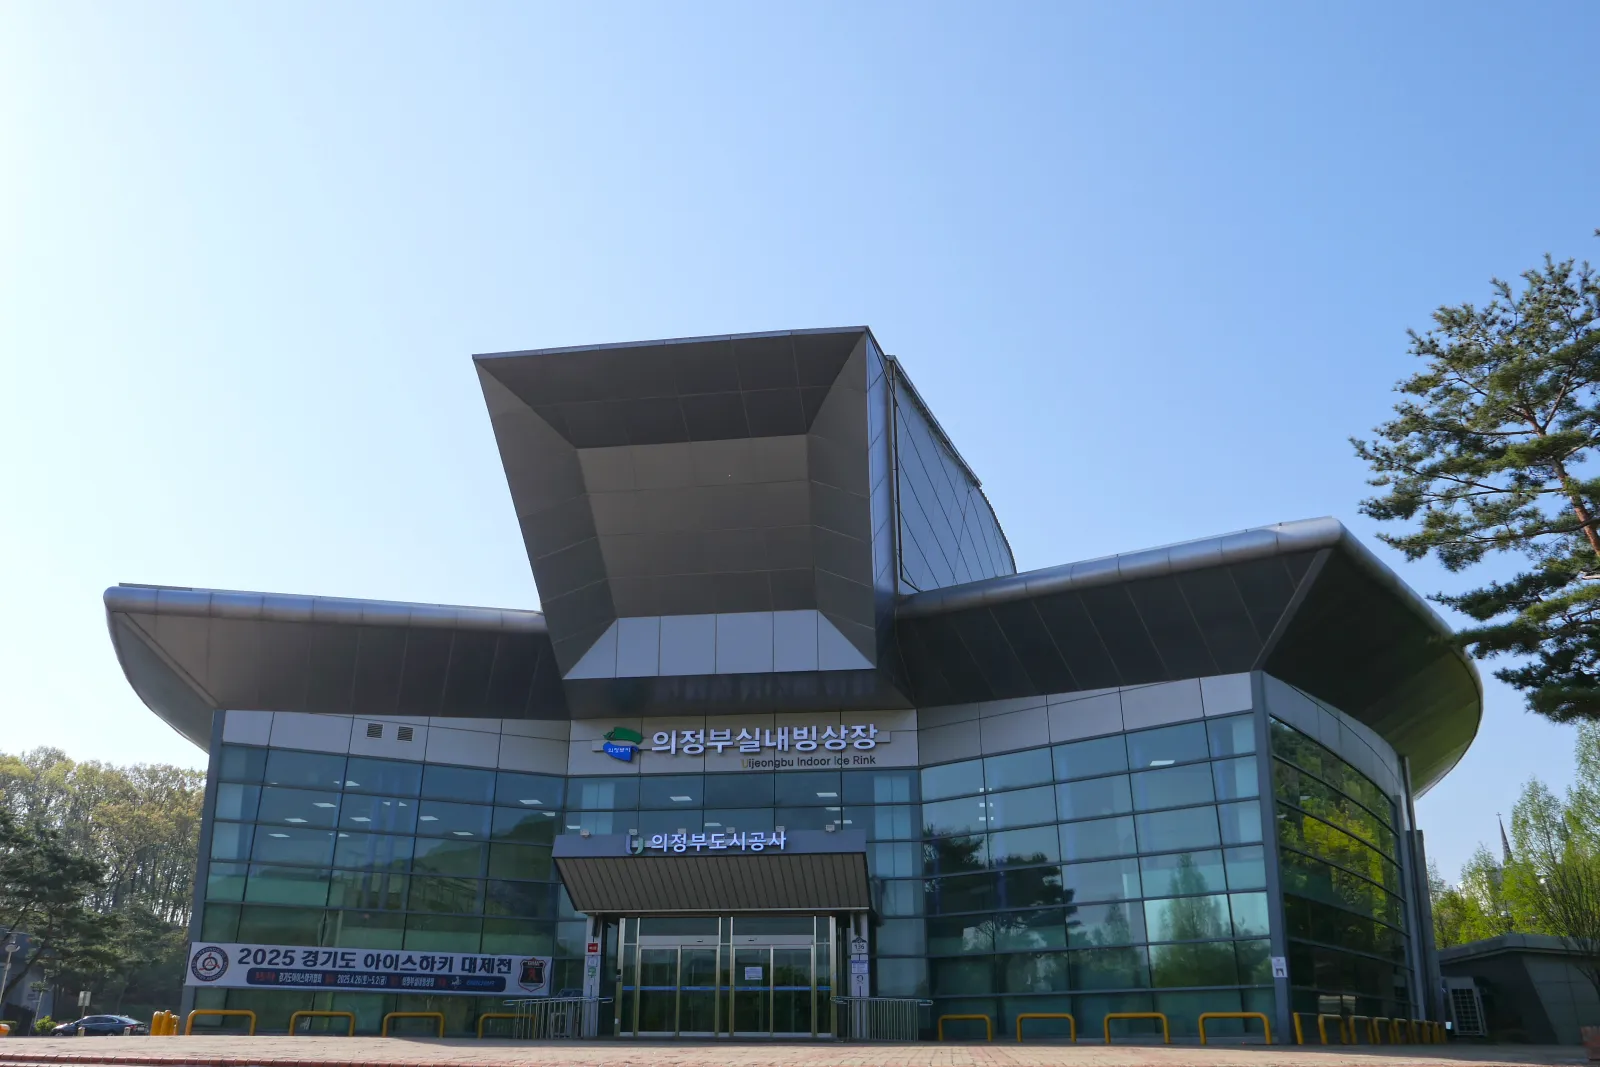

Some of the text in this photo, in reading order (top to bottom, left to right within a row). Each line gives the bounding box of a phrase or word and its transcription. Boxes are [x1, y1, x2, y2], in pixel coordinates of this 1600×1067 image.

[652, 723, 878, 755] 의정부실내빙상장
[741, 755, 876, 770] Uijeongbu Indoor Ice Rink
[651, 831, 787, 853] 의정부도시공사
[237, 947, 296, 967] 2025
[301, 949, 358, 969] 경기도
[363, 952, 455, 973] 아이스하키
[460, 955, 513, 975] 대제전
